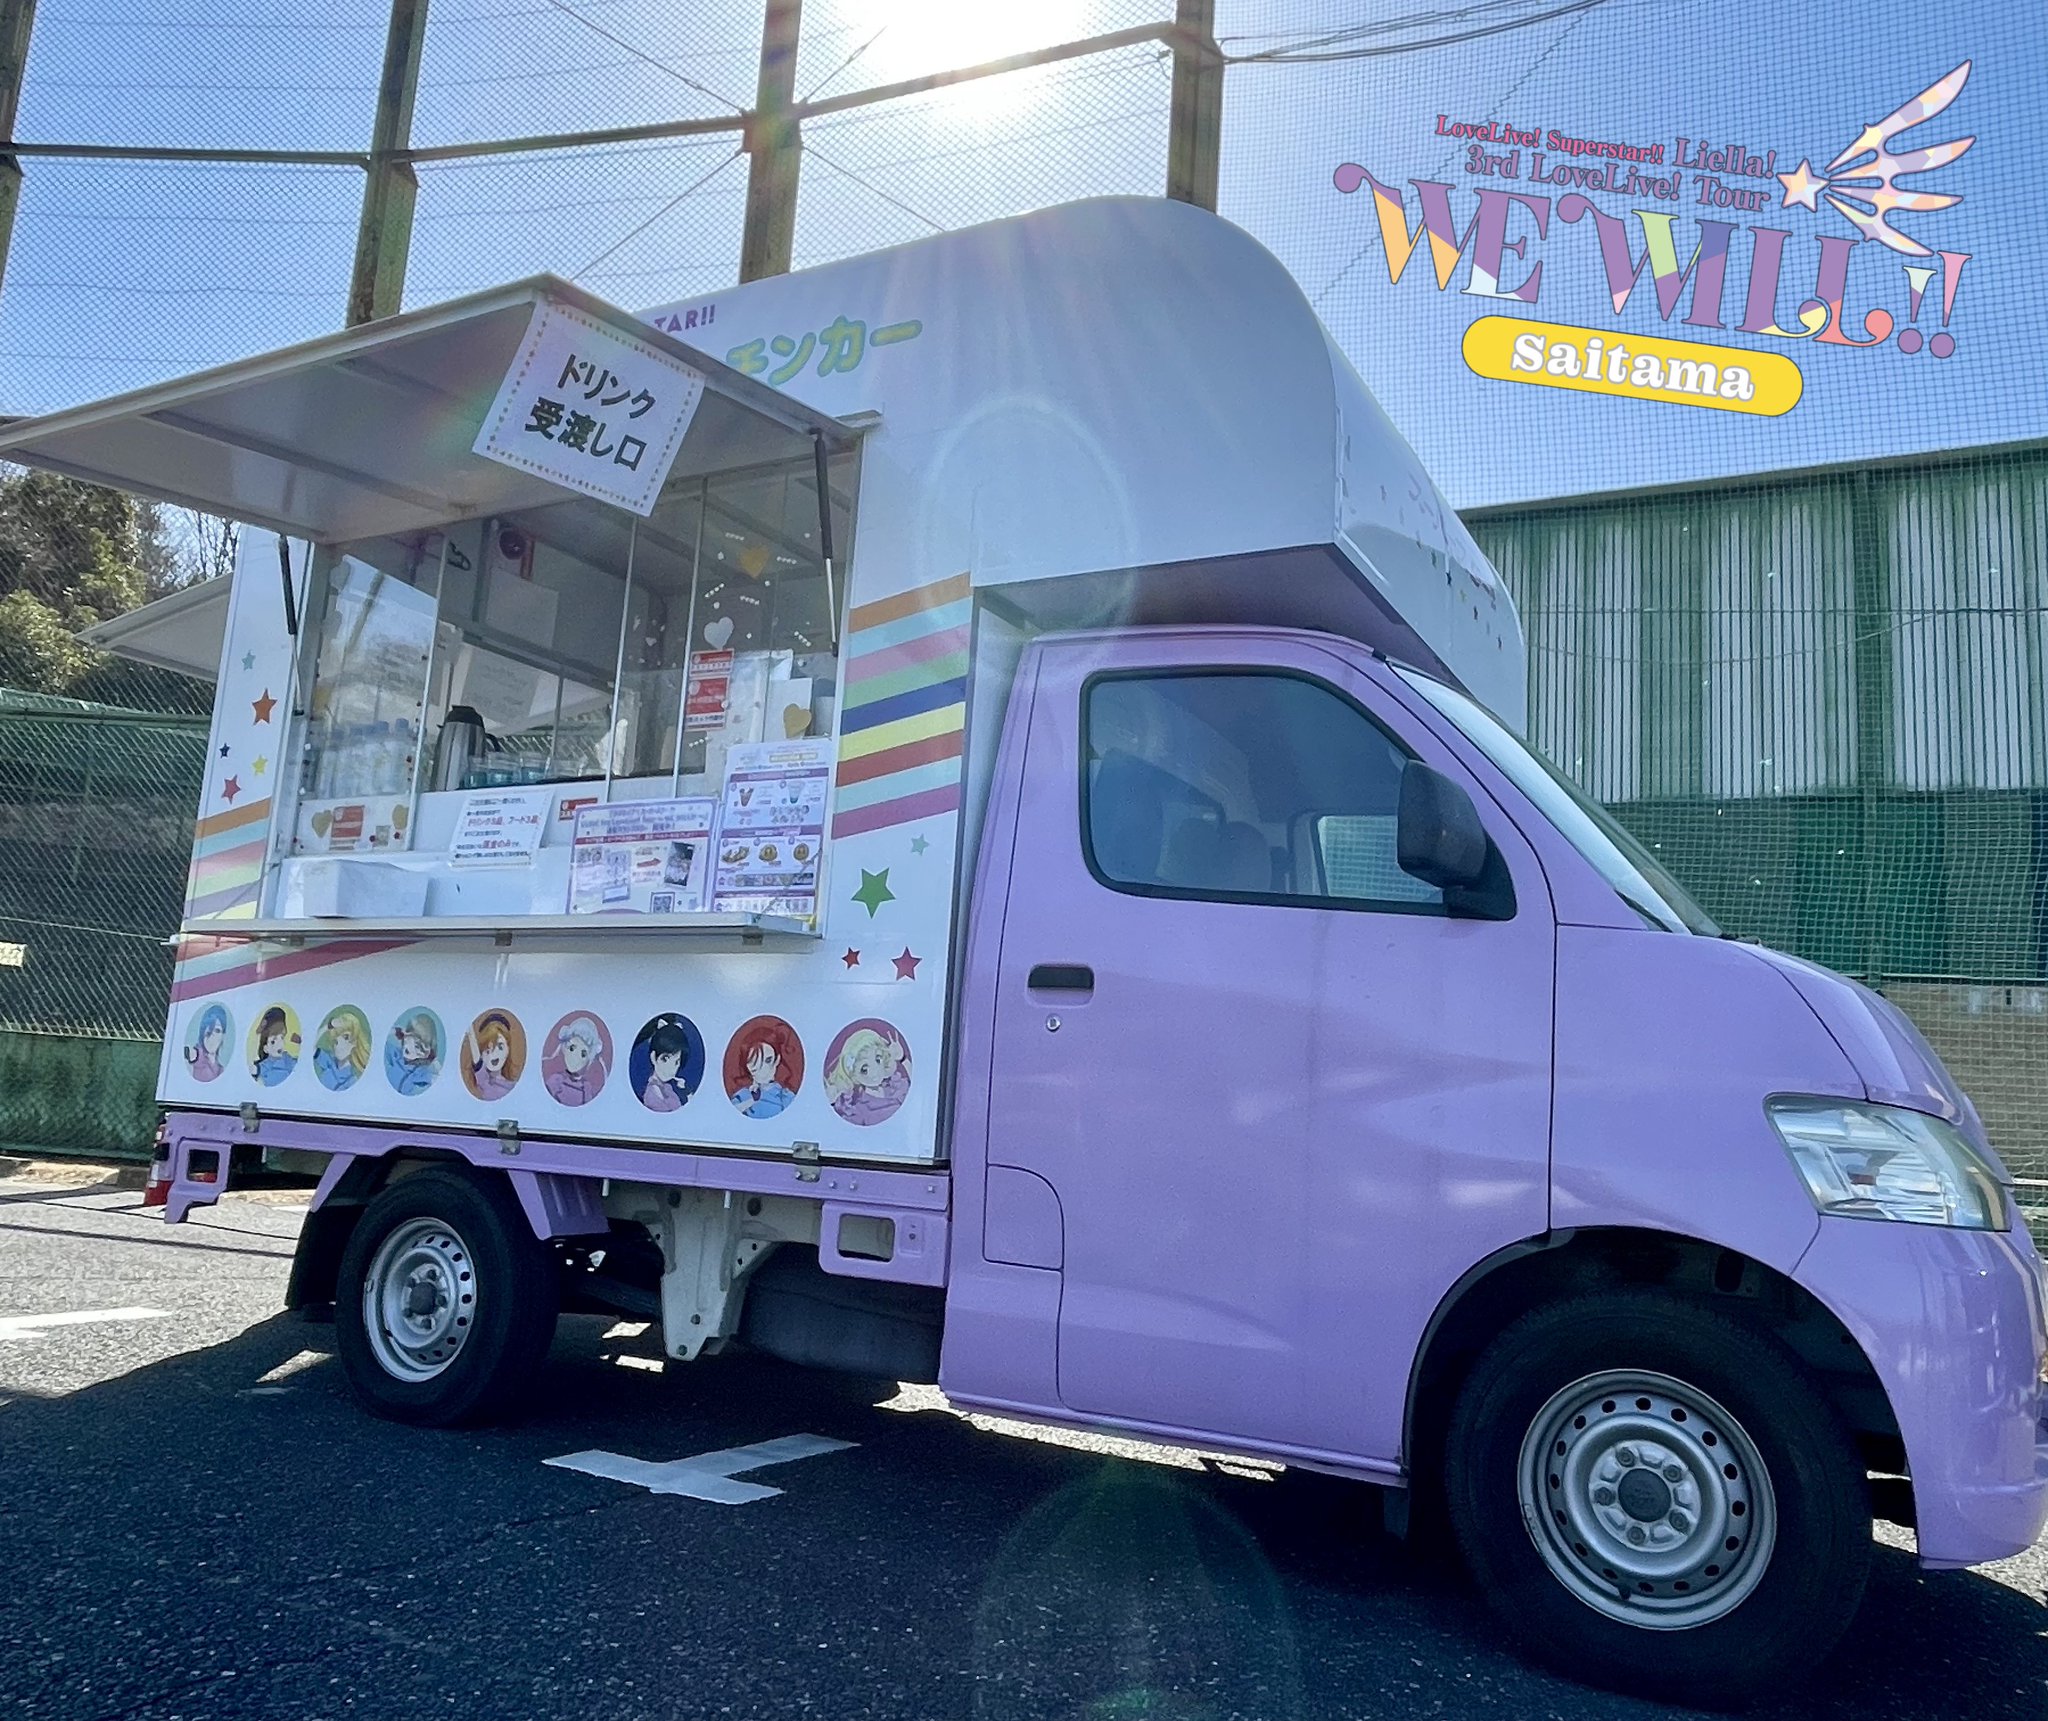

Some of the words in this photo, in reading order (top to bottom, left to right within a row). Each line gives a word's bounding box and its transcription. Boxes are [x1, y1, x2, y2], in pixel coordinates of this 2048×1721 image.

[558, 354, 656, 419] ドリンク
[525, 397, 647, 471] 受渡し口
